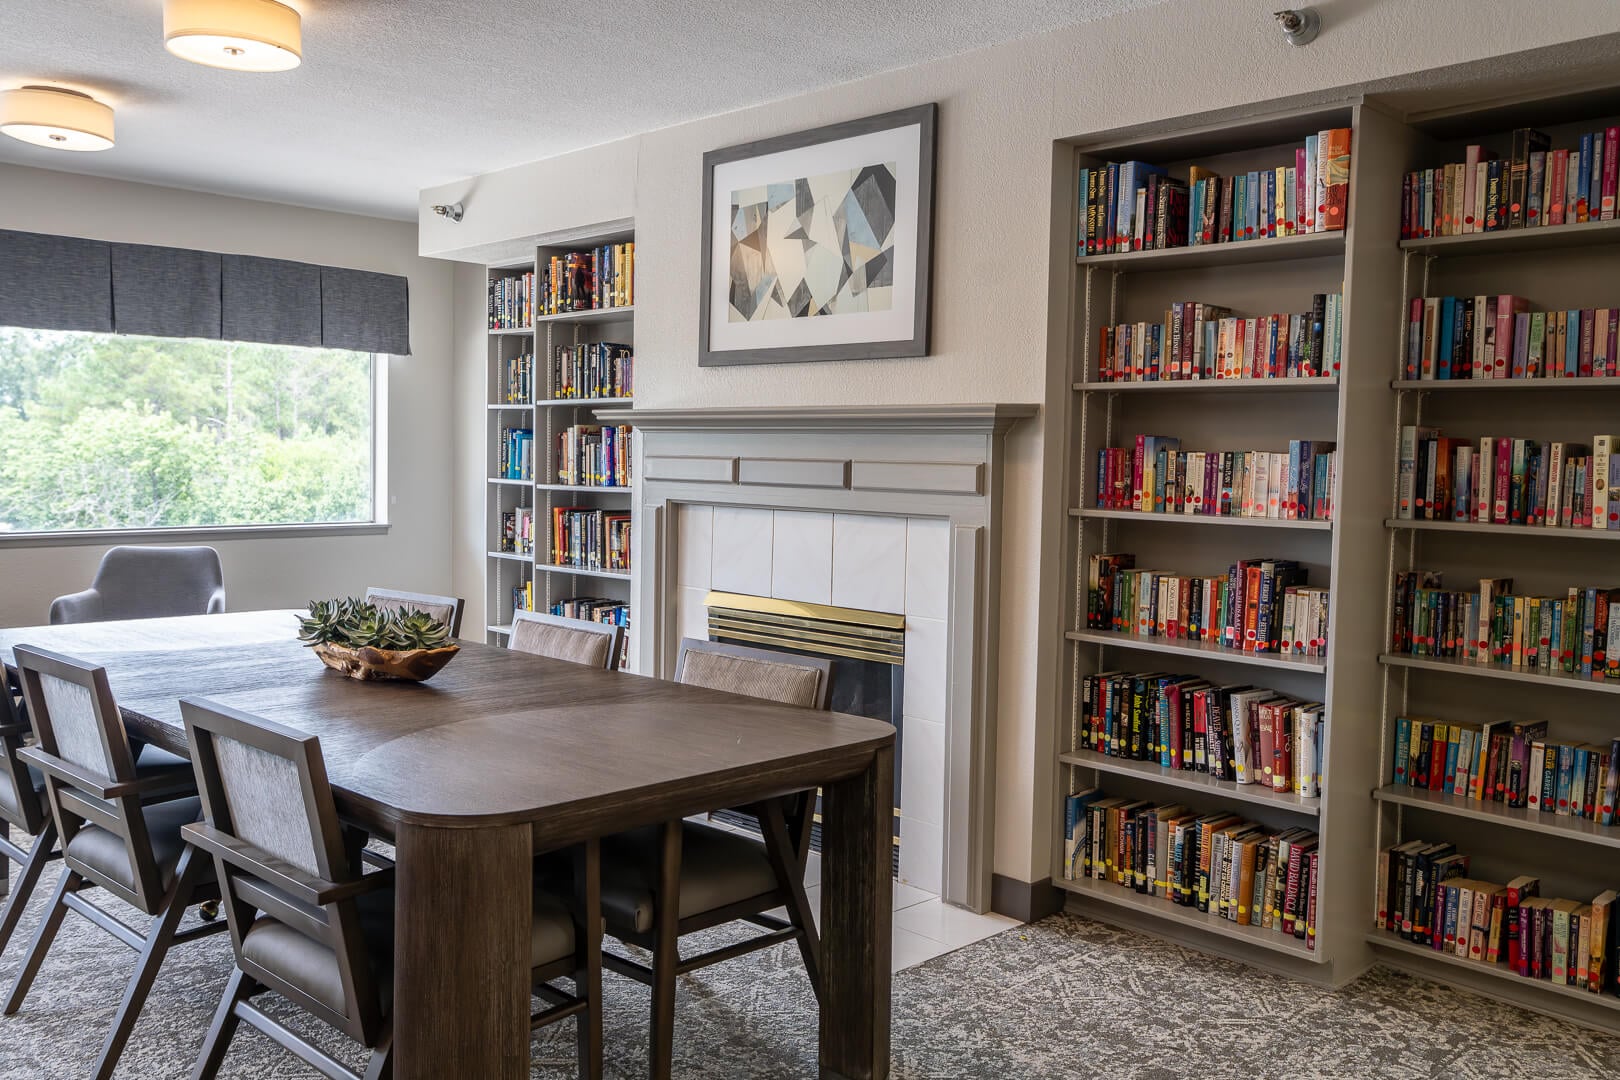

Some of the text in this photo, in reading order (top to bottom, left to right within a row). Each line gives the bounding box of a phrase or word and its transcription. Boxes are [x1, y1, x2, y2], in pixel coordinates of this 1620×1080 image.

[1132, 693, 1143, 733] John Sandford
[1212, 706, 1221, 732] DEAVER
[1286, 847, 1301, 911] DAVID BALDACCI
